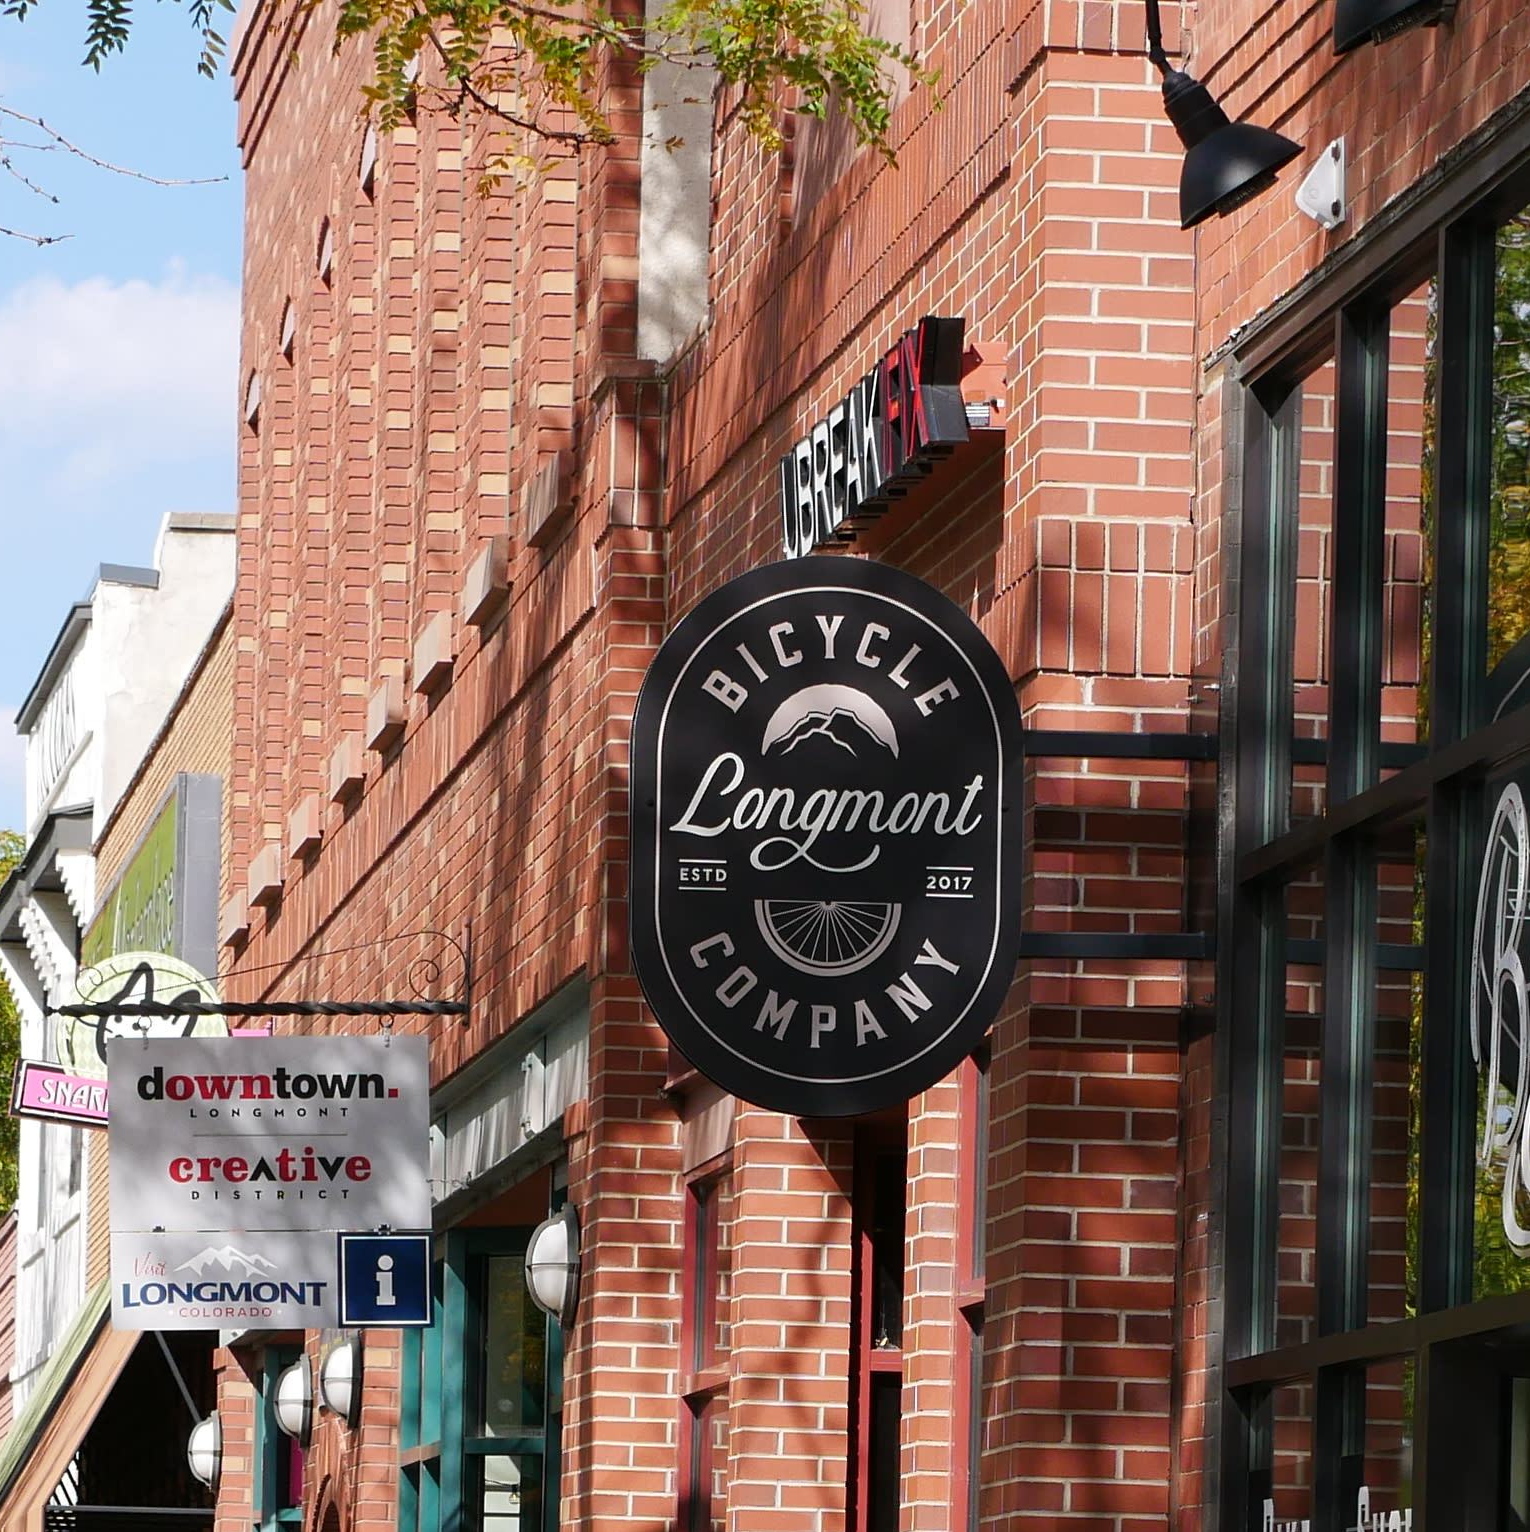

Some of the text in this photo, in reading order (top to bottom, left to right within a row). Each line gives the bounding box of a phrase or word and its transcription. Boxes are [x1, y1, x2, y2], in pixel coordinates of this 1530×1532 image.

[701, 614, 961, 718] BICYCLE
[669, 751, 984, 873] Longmont
[678, 867, 728, 883] ESTD
[926, 875, 973, 892] 2017
[689, 931, 960, 1048] COMPANY
[189, 1107, 349, 1119] LONGMONT
[191, 1189, 349, 1201] DISTRICT
[121, 1281, 328, 1309] LONGMONT
[178, 1307, 273, 1318] COLORADO
